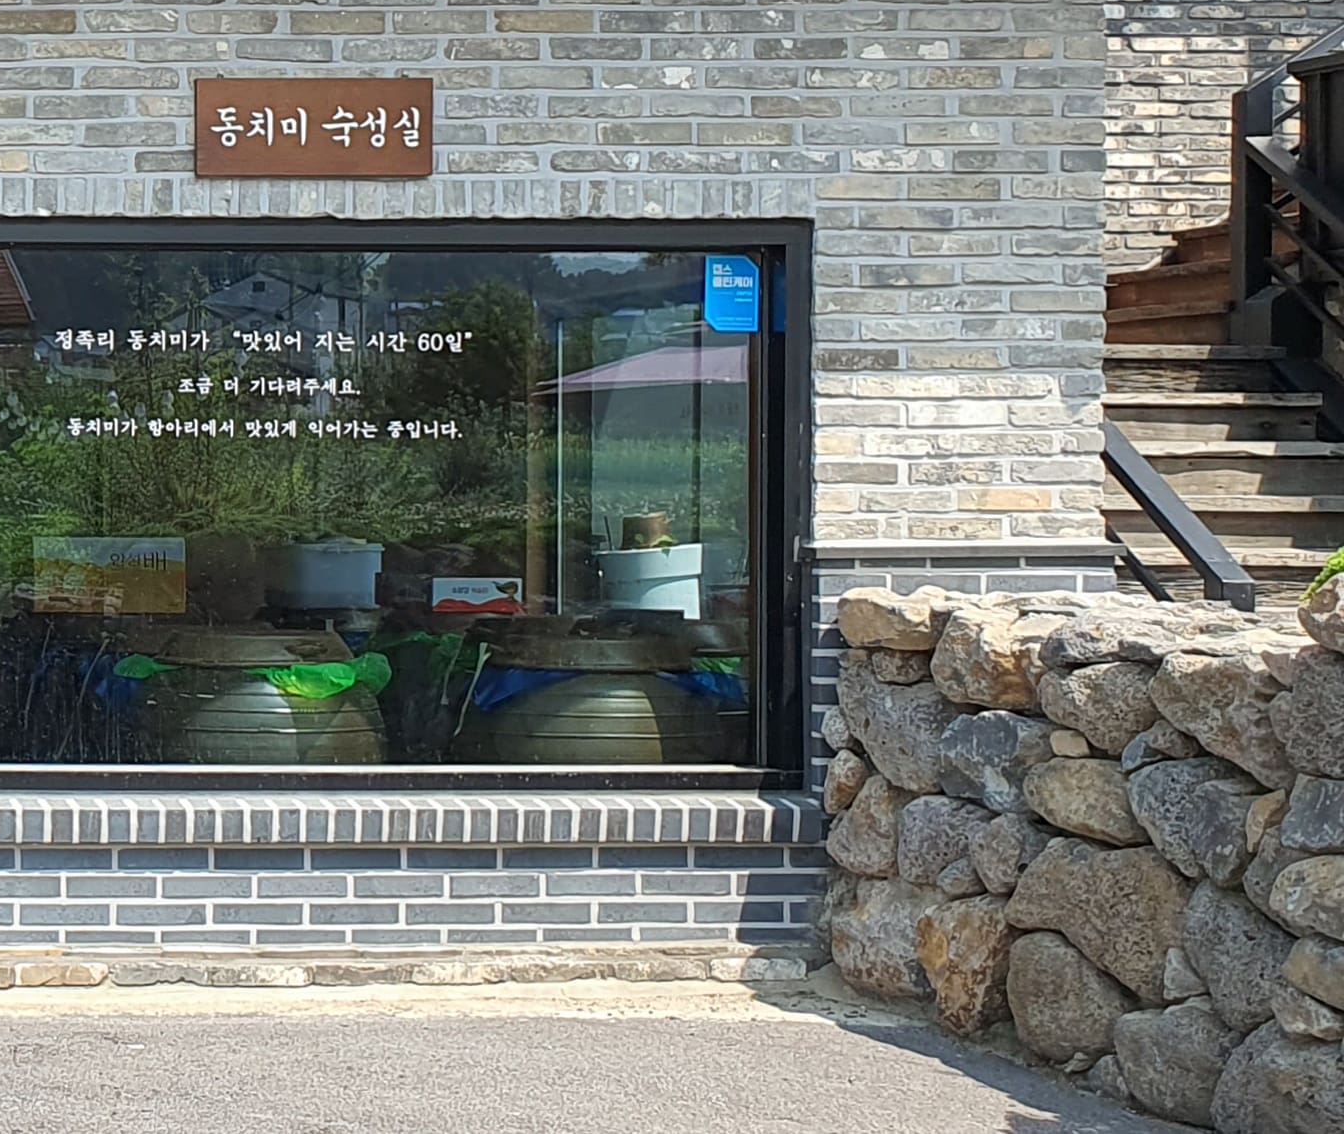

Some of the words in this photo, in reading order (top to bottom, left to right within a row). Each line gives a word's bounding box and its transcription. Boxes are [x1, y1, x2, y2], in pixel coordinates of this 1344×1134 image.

[210, 107, 307, 147] 동치미
[321, 106, 420, 148] 숙성실
[55, 329, 114, 352] 정족리
[127, 329, 210, 352] 동치미가
[315, 330, 356, 353] 지는
[366, 331, 408, 354] 시간
[178, 378, 214, 396] 조금
[223, 377, 239, 396] 더
[249, 377, 361, 396] 기다려주세요.
[67, 417, 138, 438] 동치미가
[147, 418, 235, 439] 항아리에서
[245, 419, 297, 439] 맛있게
[308, 419, 378, 440] 익어가는
[387, 420, 463, 440] 중입니다.
